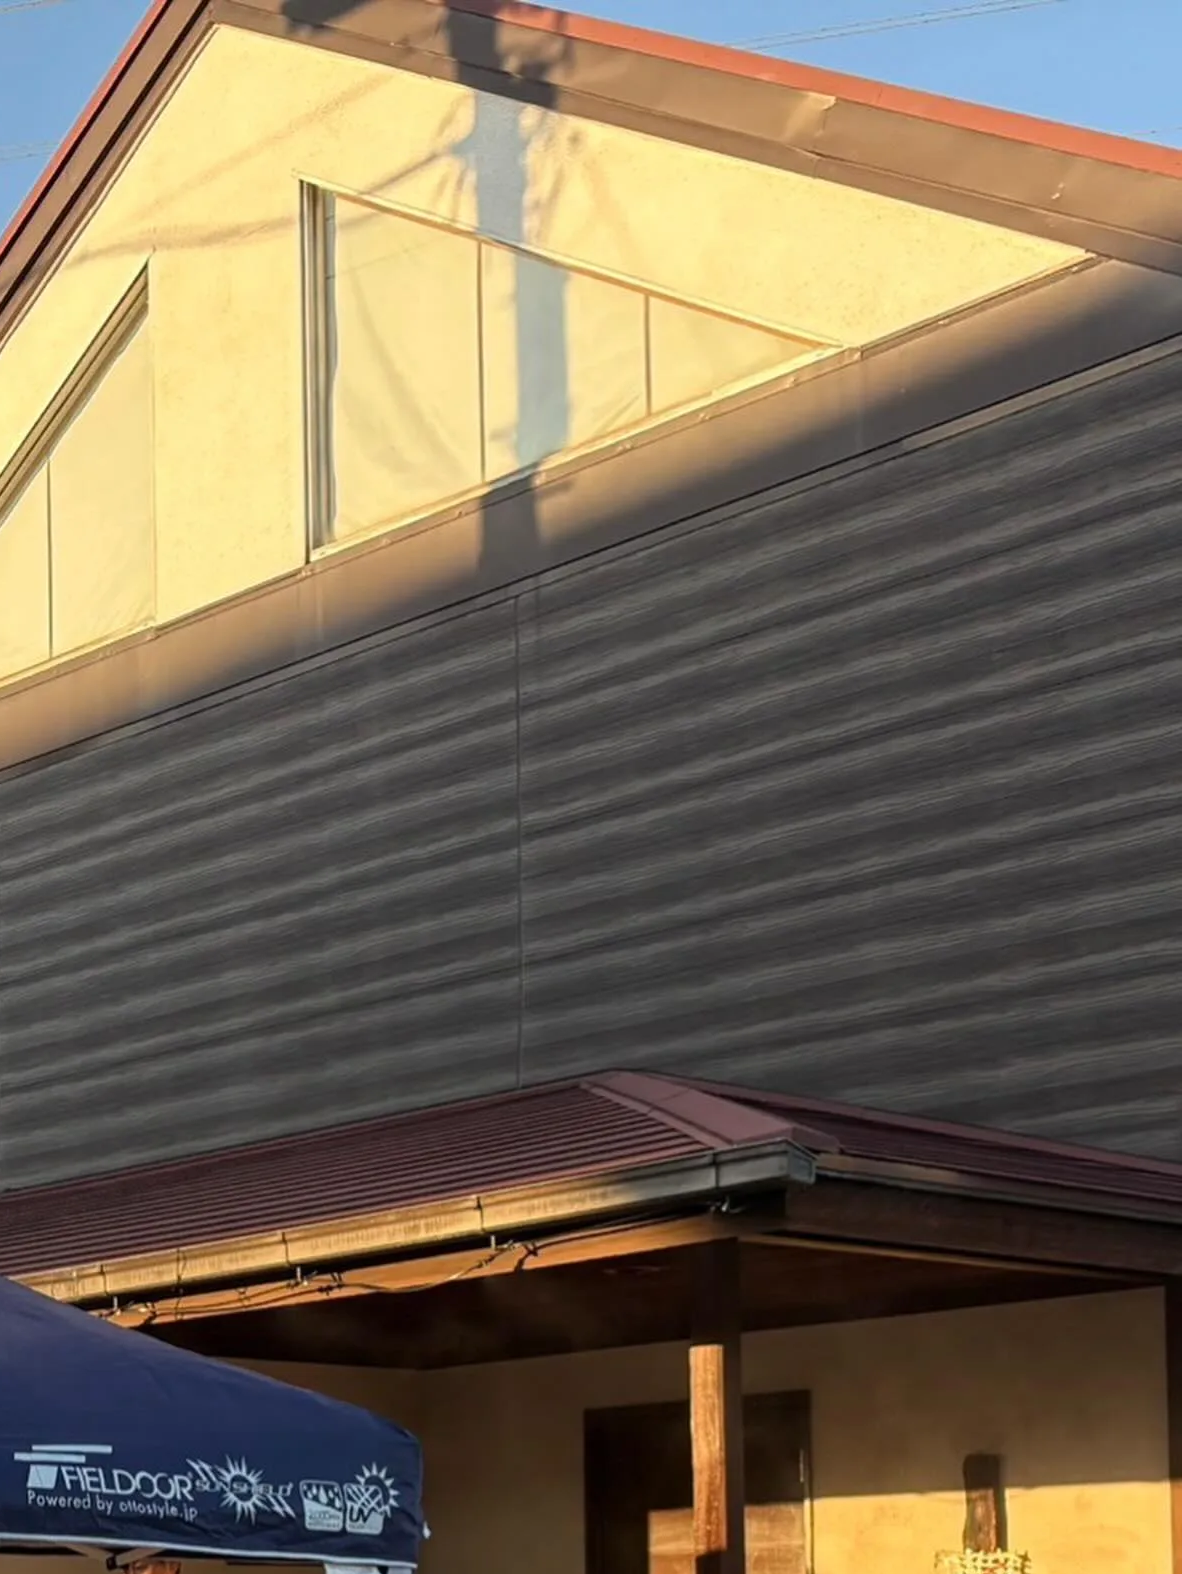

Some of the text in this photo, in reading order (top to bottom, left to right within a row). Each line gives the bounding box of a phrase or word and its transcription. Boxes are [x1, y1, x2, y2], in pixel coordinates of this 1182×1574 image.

[60, 1464, 194, 1501] FIELDOOR
[27, 1489, 91, 1510] Powered
[96, 1494, 113, 1516] by
